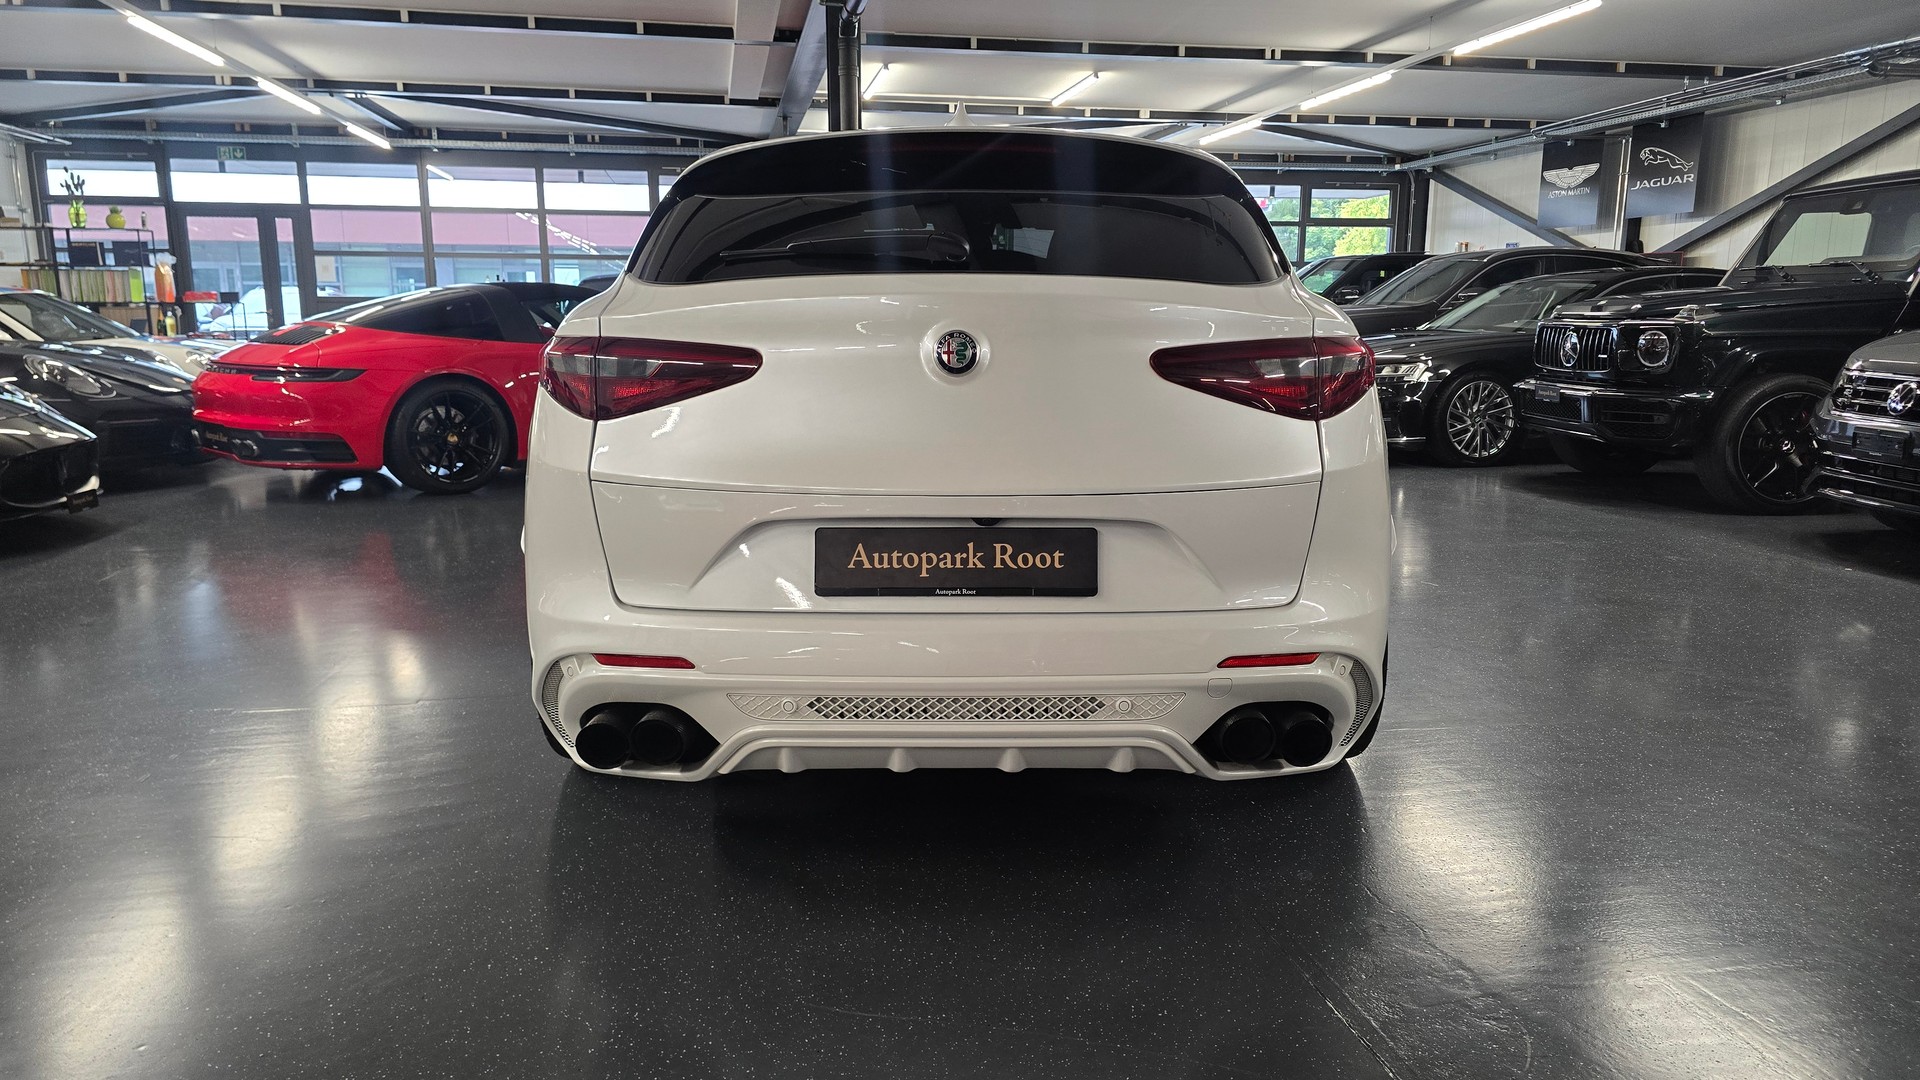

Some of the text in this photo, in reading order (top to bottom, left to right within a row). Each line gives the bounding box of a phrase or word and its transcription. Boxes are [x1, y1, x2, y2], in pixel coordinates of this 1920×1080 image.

[1631, 173, 1694, 190] JAGUAR
[1547, 187, 1590, 199] ASTON MARTIN
[937, 332, 977, 353] ALFA ROMEO
[848, 542, 1064, 577] Autopark Root
[935, 588, 961, 596] Autopark
